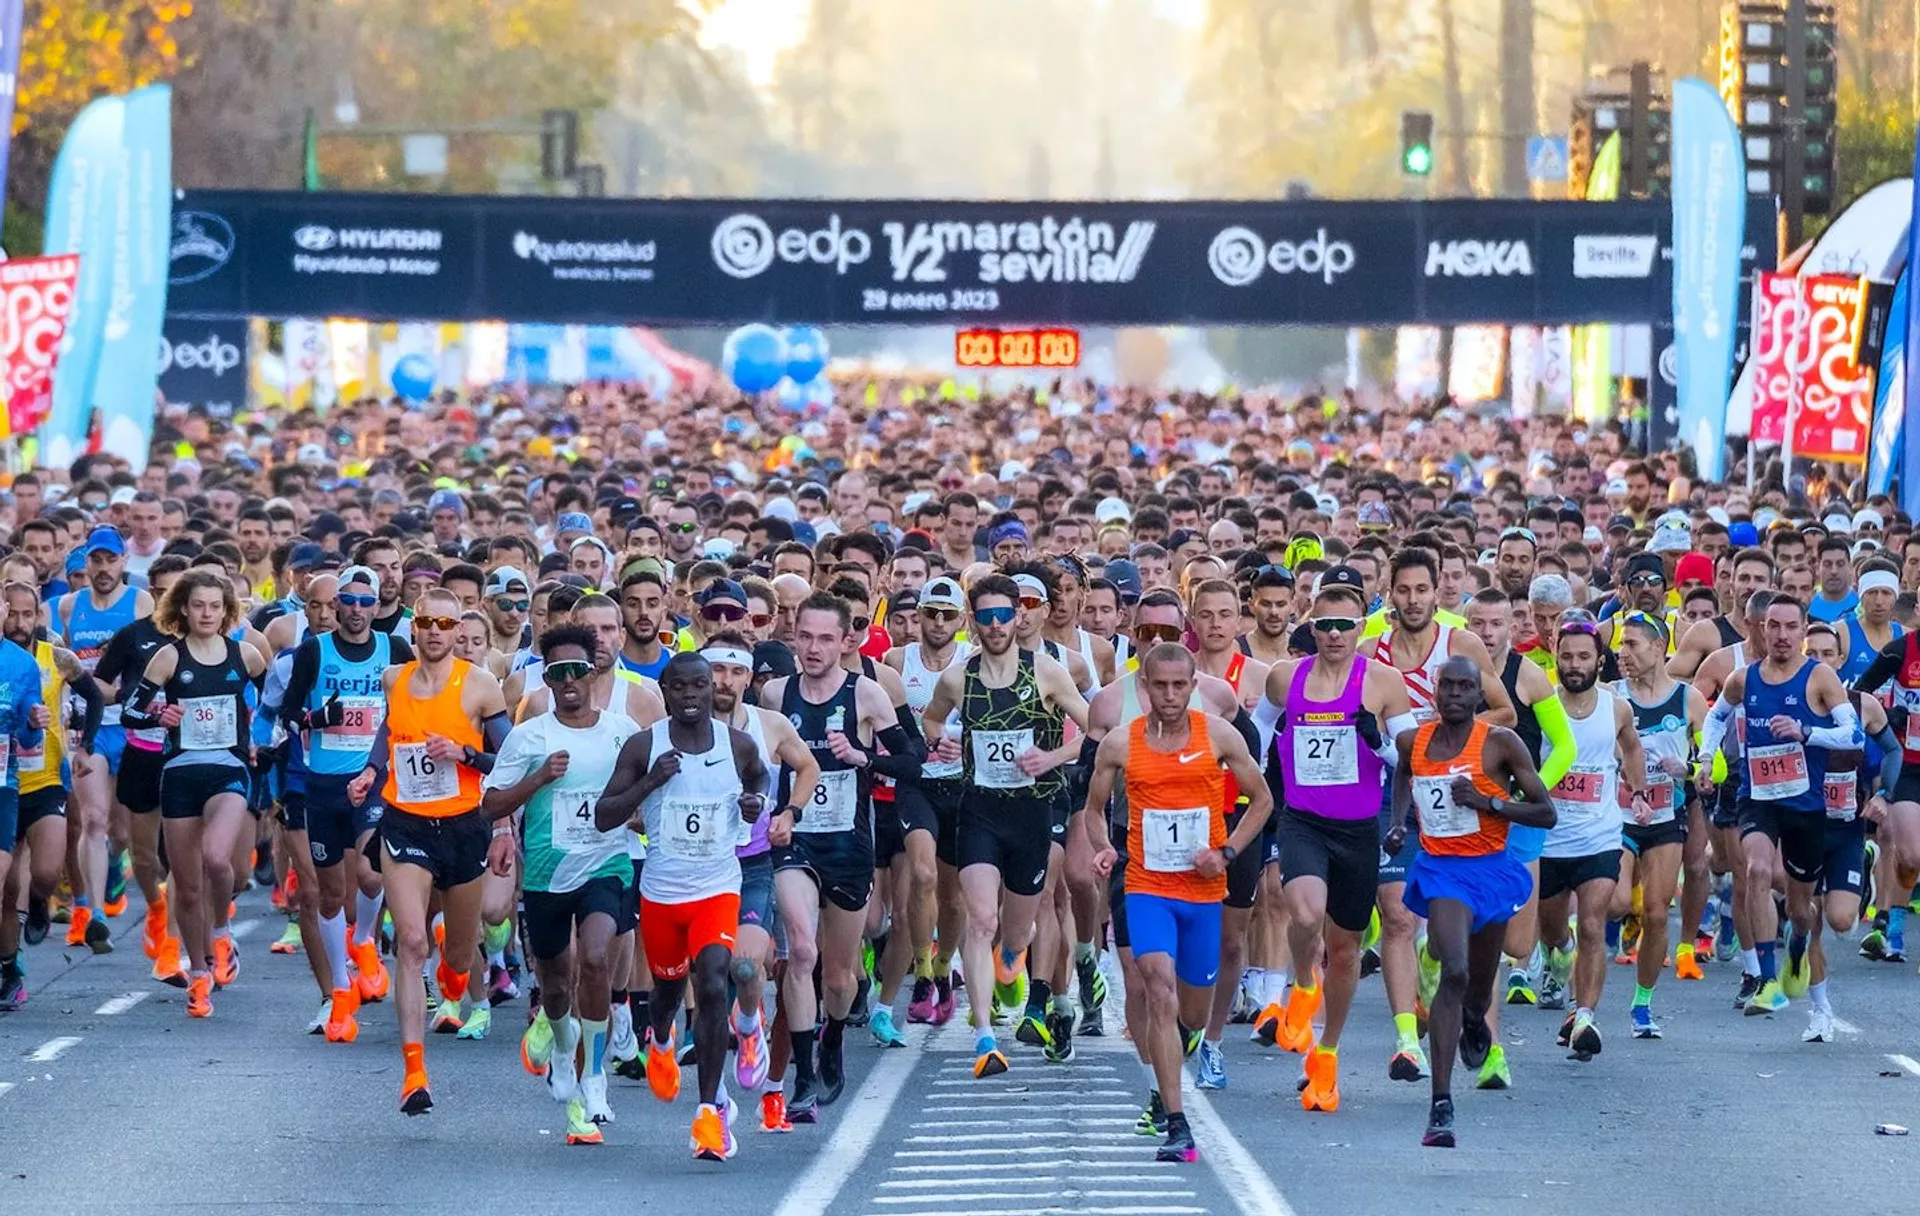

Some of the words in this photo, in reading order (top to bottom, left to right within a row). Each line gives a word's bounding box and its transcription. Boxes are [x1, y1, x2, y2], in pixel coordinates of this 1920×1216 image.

[339, 228, 443, 250] HYUNDAI
[777, 213, 871, 275] edp
[933, 215, 1115, 251] maratón
[978, 246, 1120, 283] sevilla
[1268, 226, 1355, 285] edp
[1424, 239, 1534, 277] HOKA
[862, 289, 889, 312] 29
[890, 291, 948, 312] enero
[951, 288, 1000, 311] 2023
[174, 333, 240, 377] edp
[325, 674, 384, 696] nerja
[194, 707, 214, 722] 36
[987, 742, 1015, 762] 26
[1307, 738, 1336, 759] 27
[406, 754, 436, 776] 16
[1760, 758, 1786, 777] 911
[814, 784, 828, 805] 8
[1430, 787, 1446, 809] 2
[576, 800, 592, 821] 4
[685, 812, 700, 834] 6
[1167, 822, 1179, 843] 1
